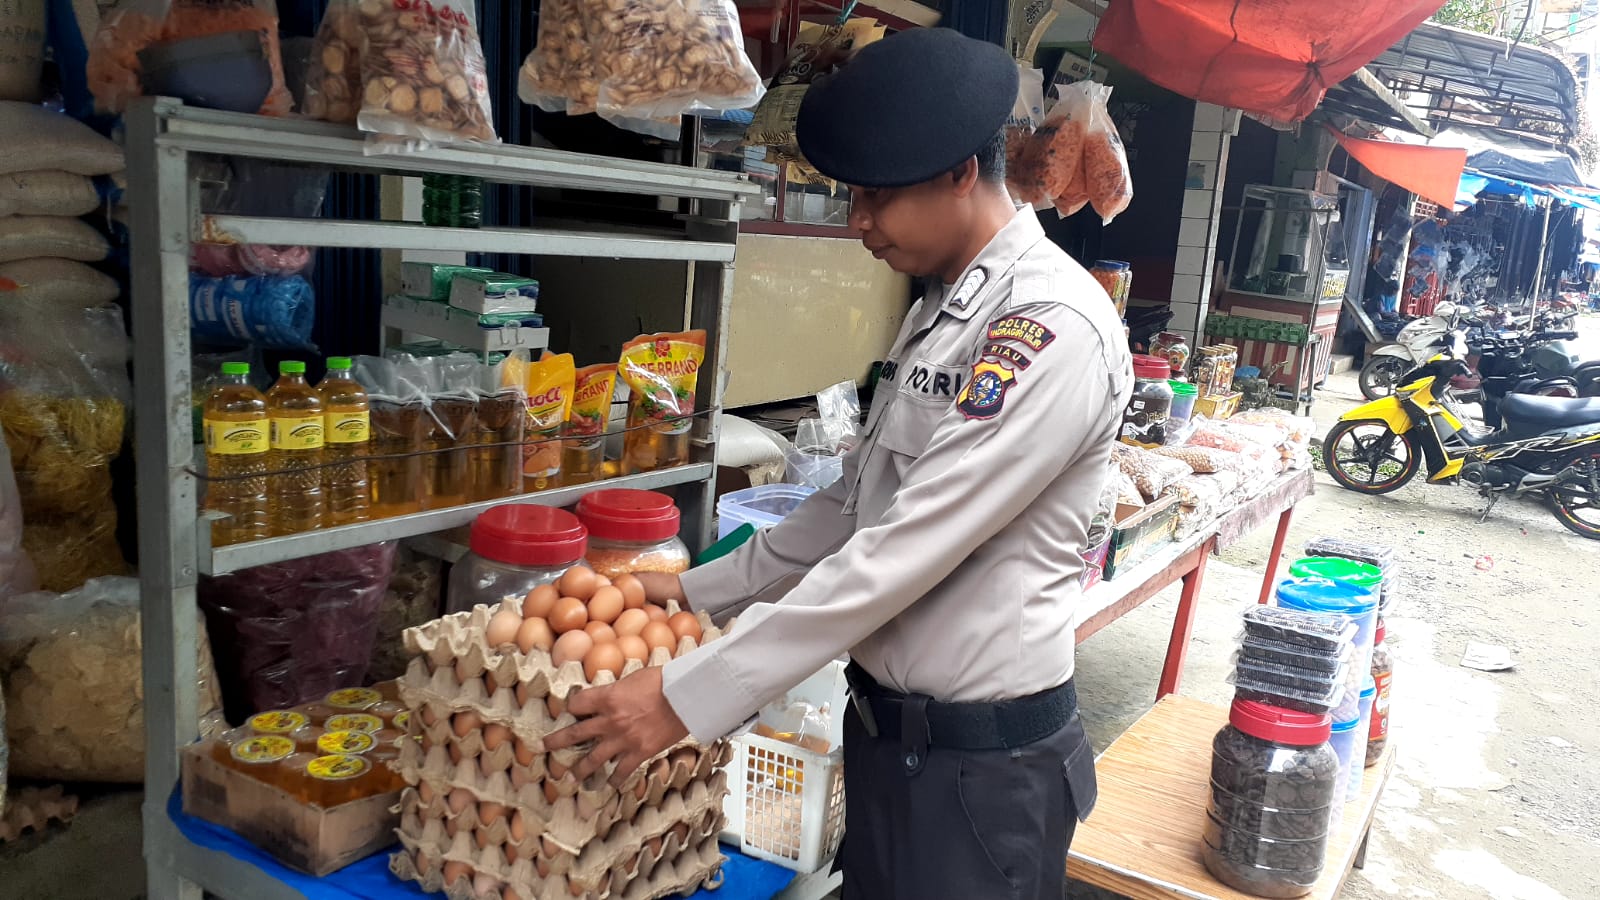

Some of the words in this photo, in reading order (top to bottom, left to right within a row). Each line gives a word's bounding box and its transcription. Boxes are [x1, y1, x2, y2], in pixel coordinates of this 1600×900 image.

[998, 318, 1045, 338] POLRES
[991, 345, 1021, 361] RIAU
[657, 358, 698, 378] BRAND
[906, 365, 962, 396] POLRI
